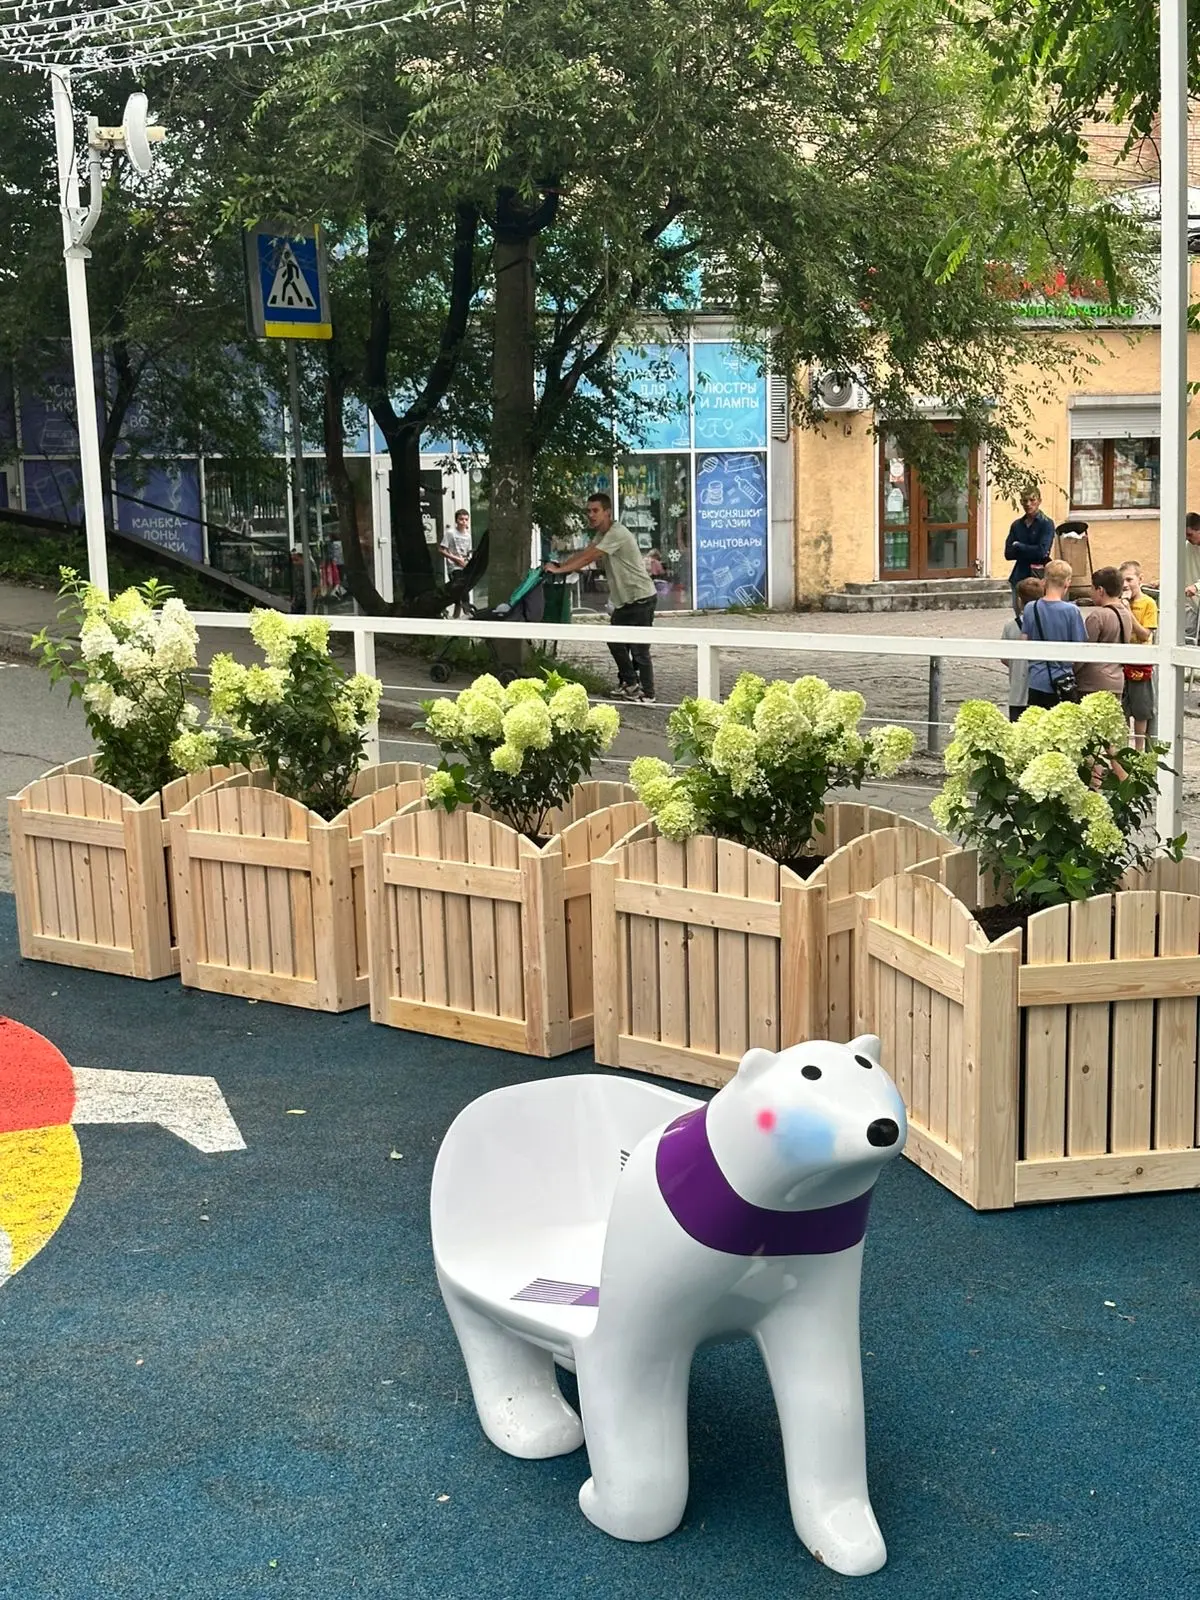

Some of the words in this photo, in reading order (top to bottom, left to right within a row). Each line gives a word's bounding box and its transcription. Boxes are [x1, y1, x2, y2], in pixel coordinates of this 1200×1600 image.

[640, 384, 667, 398] ДЛЯ
[703, 382, 757, 395] ЛЮСТРЫ
[700, 397, 710, 409] И
[714, 398, 759, 409] ЛАМПЫ
[131, 517, 188, 529] КАНЕКА-
[711, 519, 724, 528] ИЗ
[726, 518, 751, 528] АЗИИ
[700, 538, 762, 549] КАНЦТОВАРЫ
